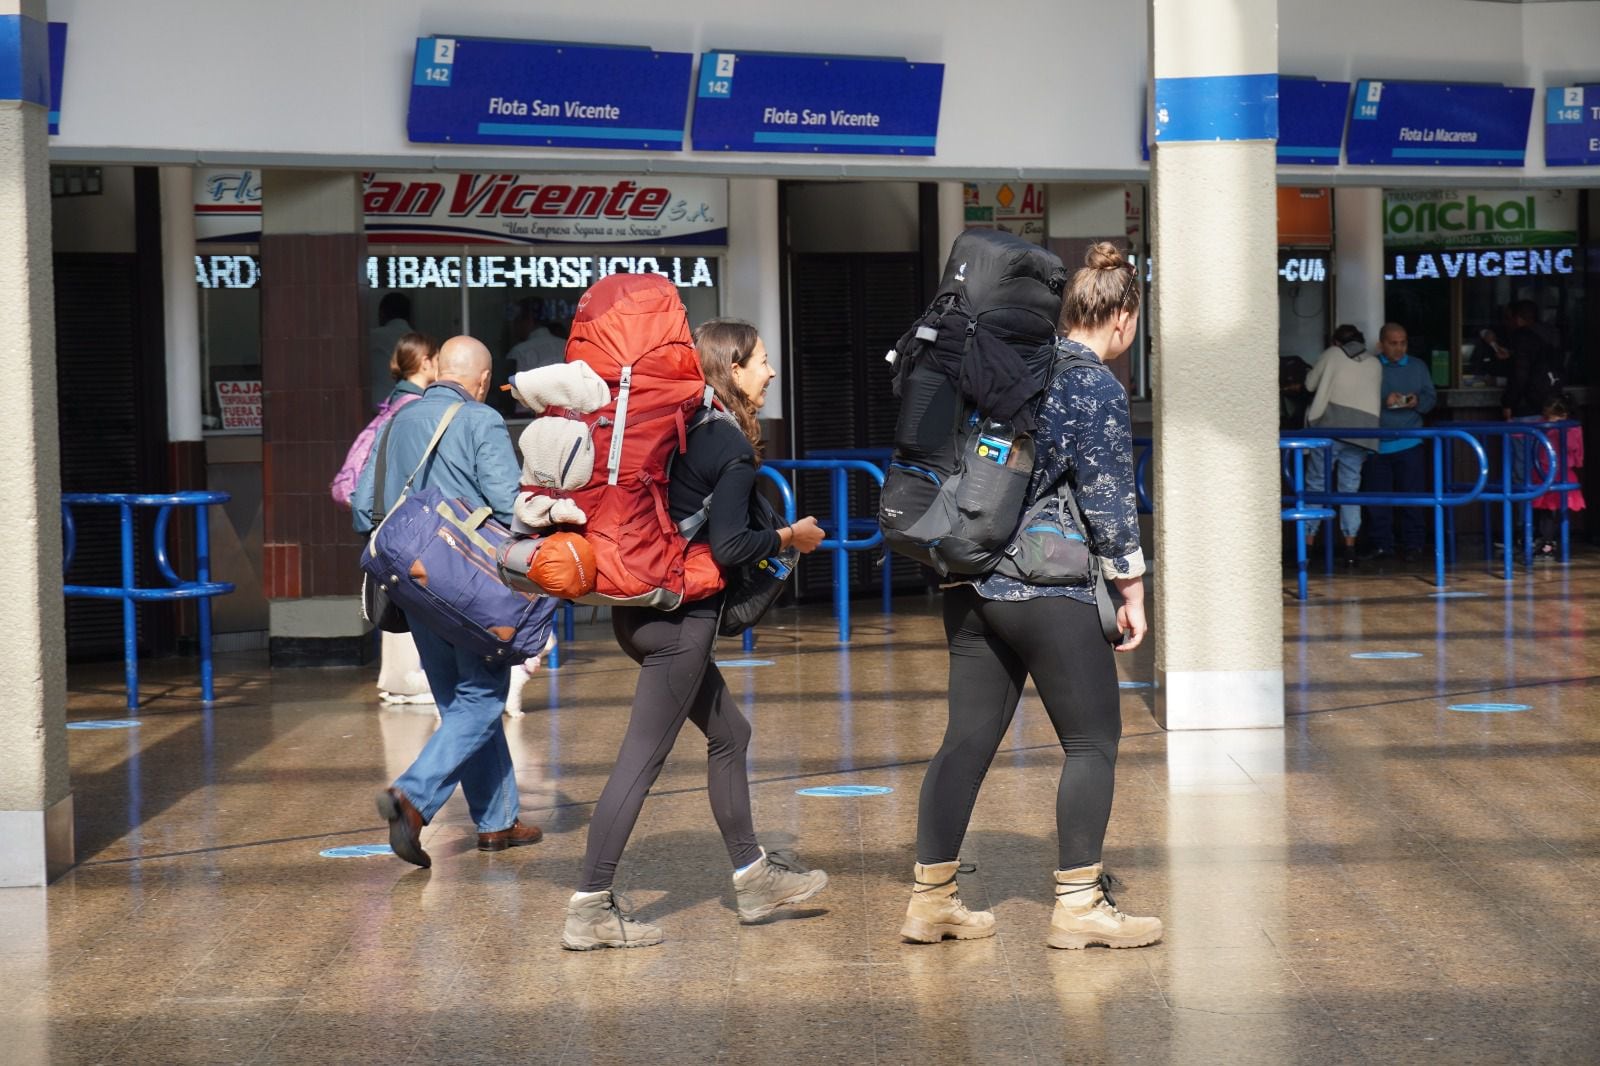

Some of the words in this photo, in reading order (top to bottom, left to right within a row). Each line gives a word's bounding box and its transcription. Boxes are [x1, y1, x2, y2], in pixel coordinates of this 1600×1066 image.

[440, 45, 449, 58] 2
[721, 60, 729, 71] 2
[425, 68, 449, 82] 142
[708, 81, 729, 94] 142
[1372, 86, 1378, 97] 2
[1569, 92, 1579, 102] 2
[488, 97, 527, 116] Flota
[532, 100, 560, 117] San
[564, 101, 620, 119] Vicente
[1361, 105, 1377, 116] 144
[1590, 107, 1600, 120] T
[763, 107, 798, 125] Flota
[801, 109, 827, 126] San
[830, 110, 880, 127] Vicente
[1557, 109, 1581, 121] 146
[1399, 127, 1422, 141] Flota
[1423, 128, 1434, 142] La
[1434, 128, 1478, 143] Macarena
[1589, 138, 1600, 152] E
[362, 172, 445, 217] an
[448, 172, 672, 219] Vicente
[219, 383, 262, 394] CAJA
